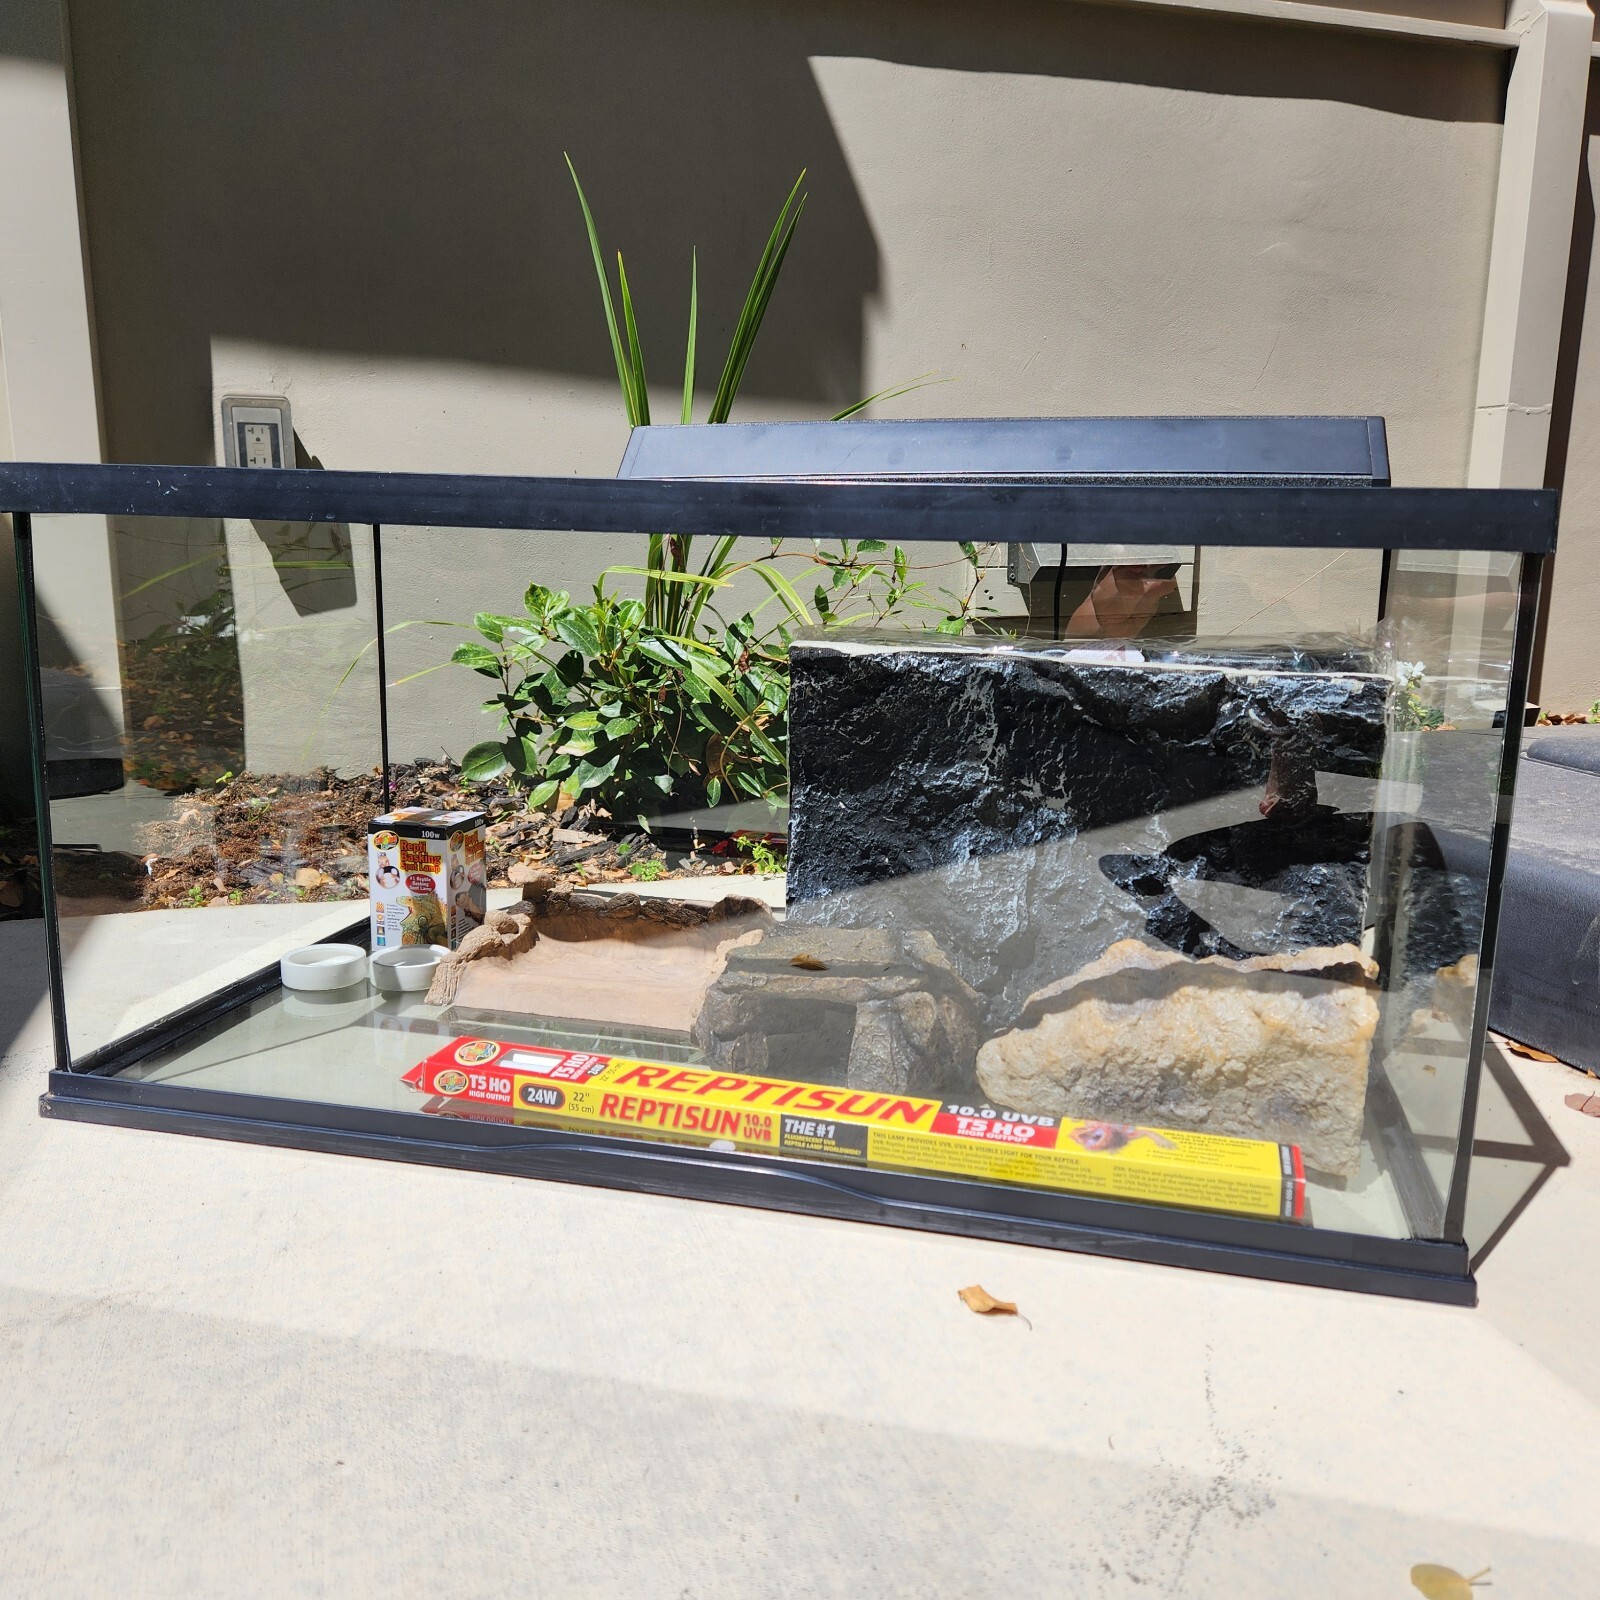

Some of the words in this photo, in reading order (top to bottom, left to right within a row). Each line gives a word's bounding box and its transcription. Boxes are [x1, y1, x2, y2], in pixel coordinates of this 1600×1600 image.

[400, 840, 426, 852] Repti
[400, 852, 441, 865] Basking
[400, 861, 418, 871] Spot
[420, 863, 441, 874] Lamp
[550, 1066, 575, 1078] T5
[563, 1054, 590, 1068] HO
[469, 1074, 486, 1090] T5
[489, 1078, 511, 1094] HO
[469, 1090, 484, 1098] HIGH
[486, 1092, 511, 1102] OUTPUT
[527, 1087, 558, 1105] 24W
[615, 1064, 935, 1124] REPTISUN
[600, 1093, 742, 1136] REPTISUN
[744, 1113, 772, 1128] 10.0
[947, 1104, 996, 1119] 10.0
[1001, 1112, 1055, 1128] UVB
[743, 1126, 772, 1141] UVB
[784, 1118, 816, 1136] THE
[816, 1123, 836, 1138] #1
[956, 1116, 989, 1132] T5
[992, 1122, 1036, 1138] HO
[784, 1134, 823, 1144] FLUORESCENT
[957, 1129, 984, 1137] HIGH
[986, 1132, 1028, 1143] OUTPUT
[784, 1140, 806, 1148] REPTILE
